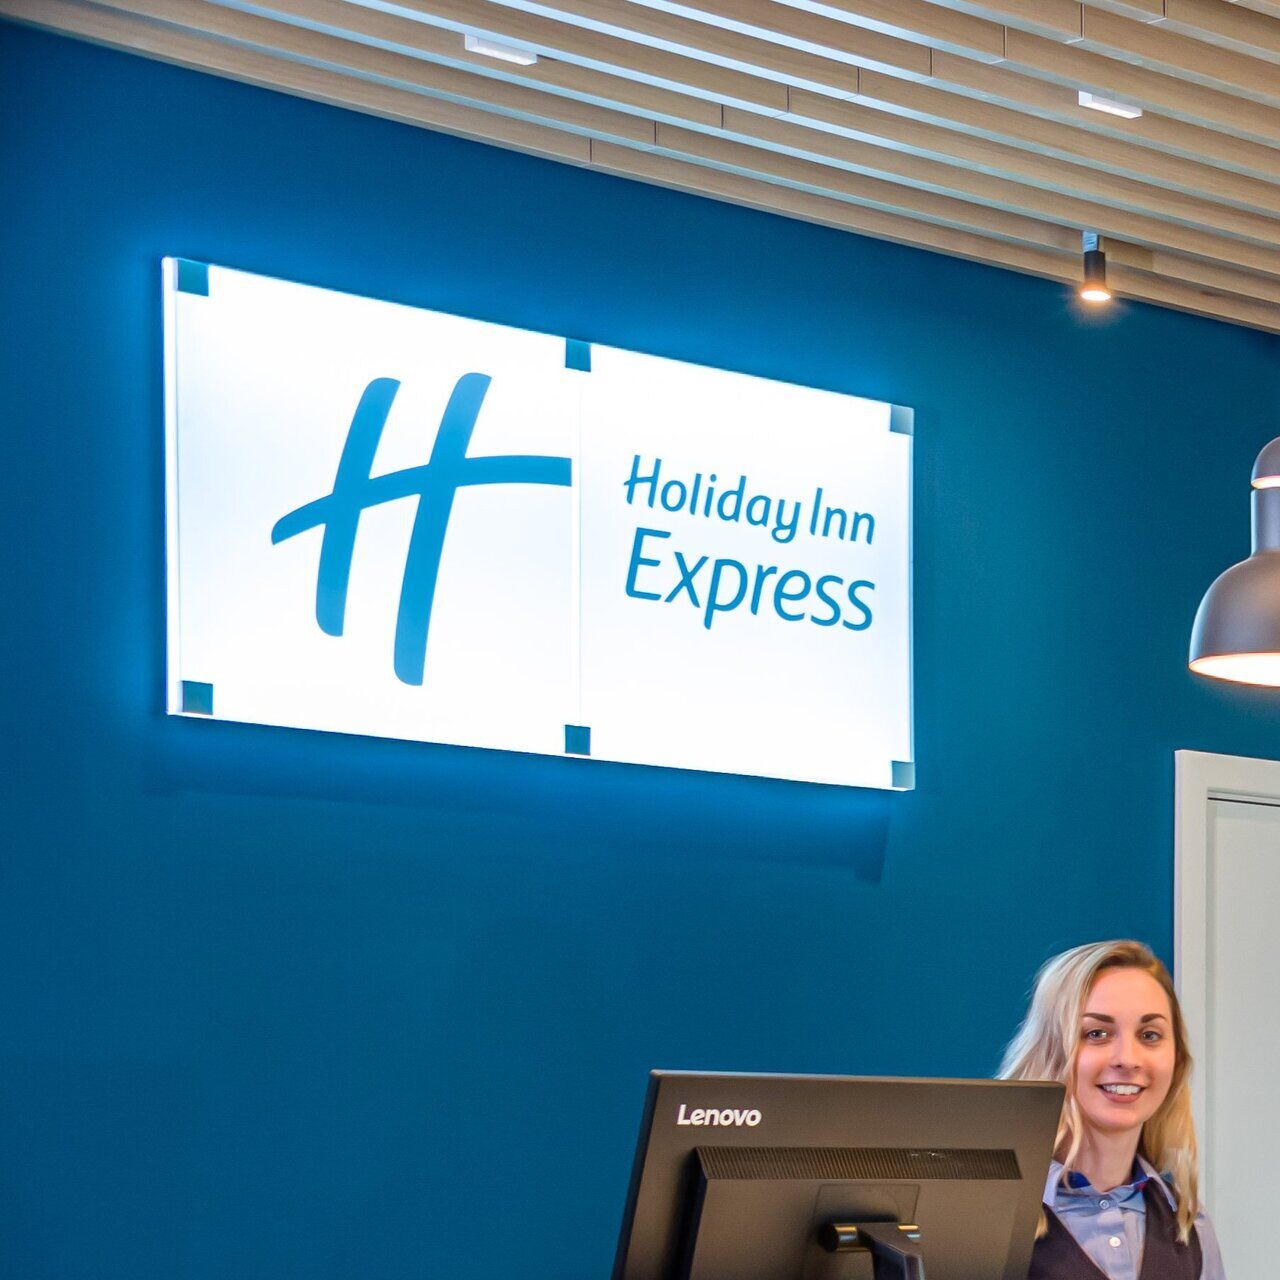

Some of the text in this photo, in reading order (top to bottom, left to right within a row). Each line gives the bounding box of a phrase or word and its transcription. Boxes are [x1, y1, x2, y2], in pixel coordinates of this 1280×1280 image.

[623, 454, 876, 545] Holiday Inn
[625, 529, 877, 631] Express
[675, 1104, 762, 1127] Lenovo
